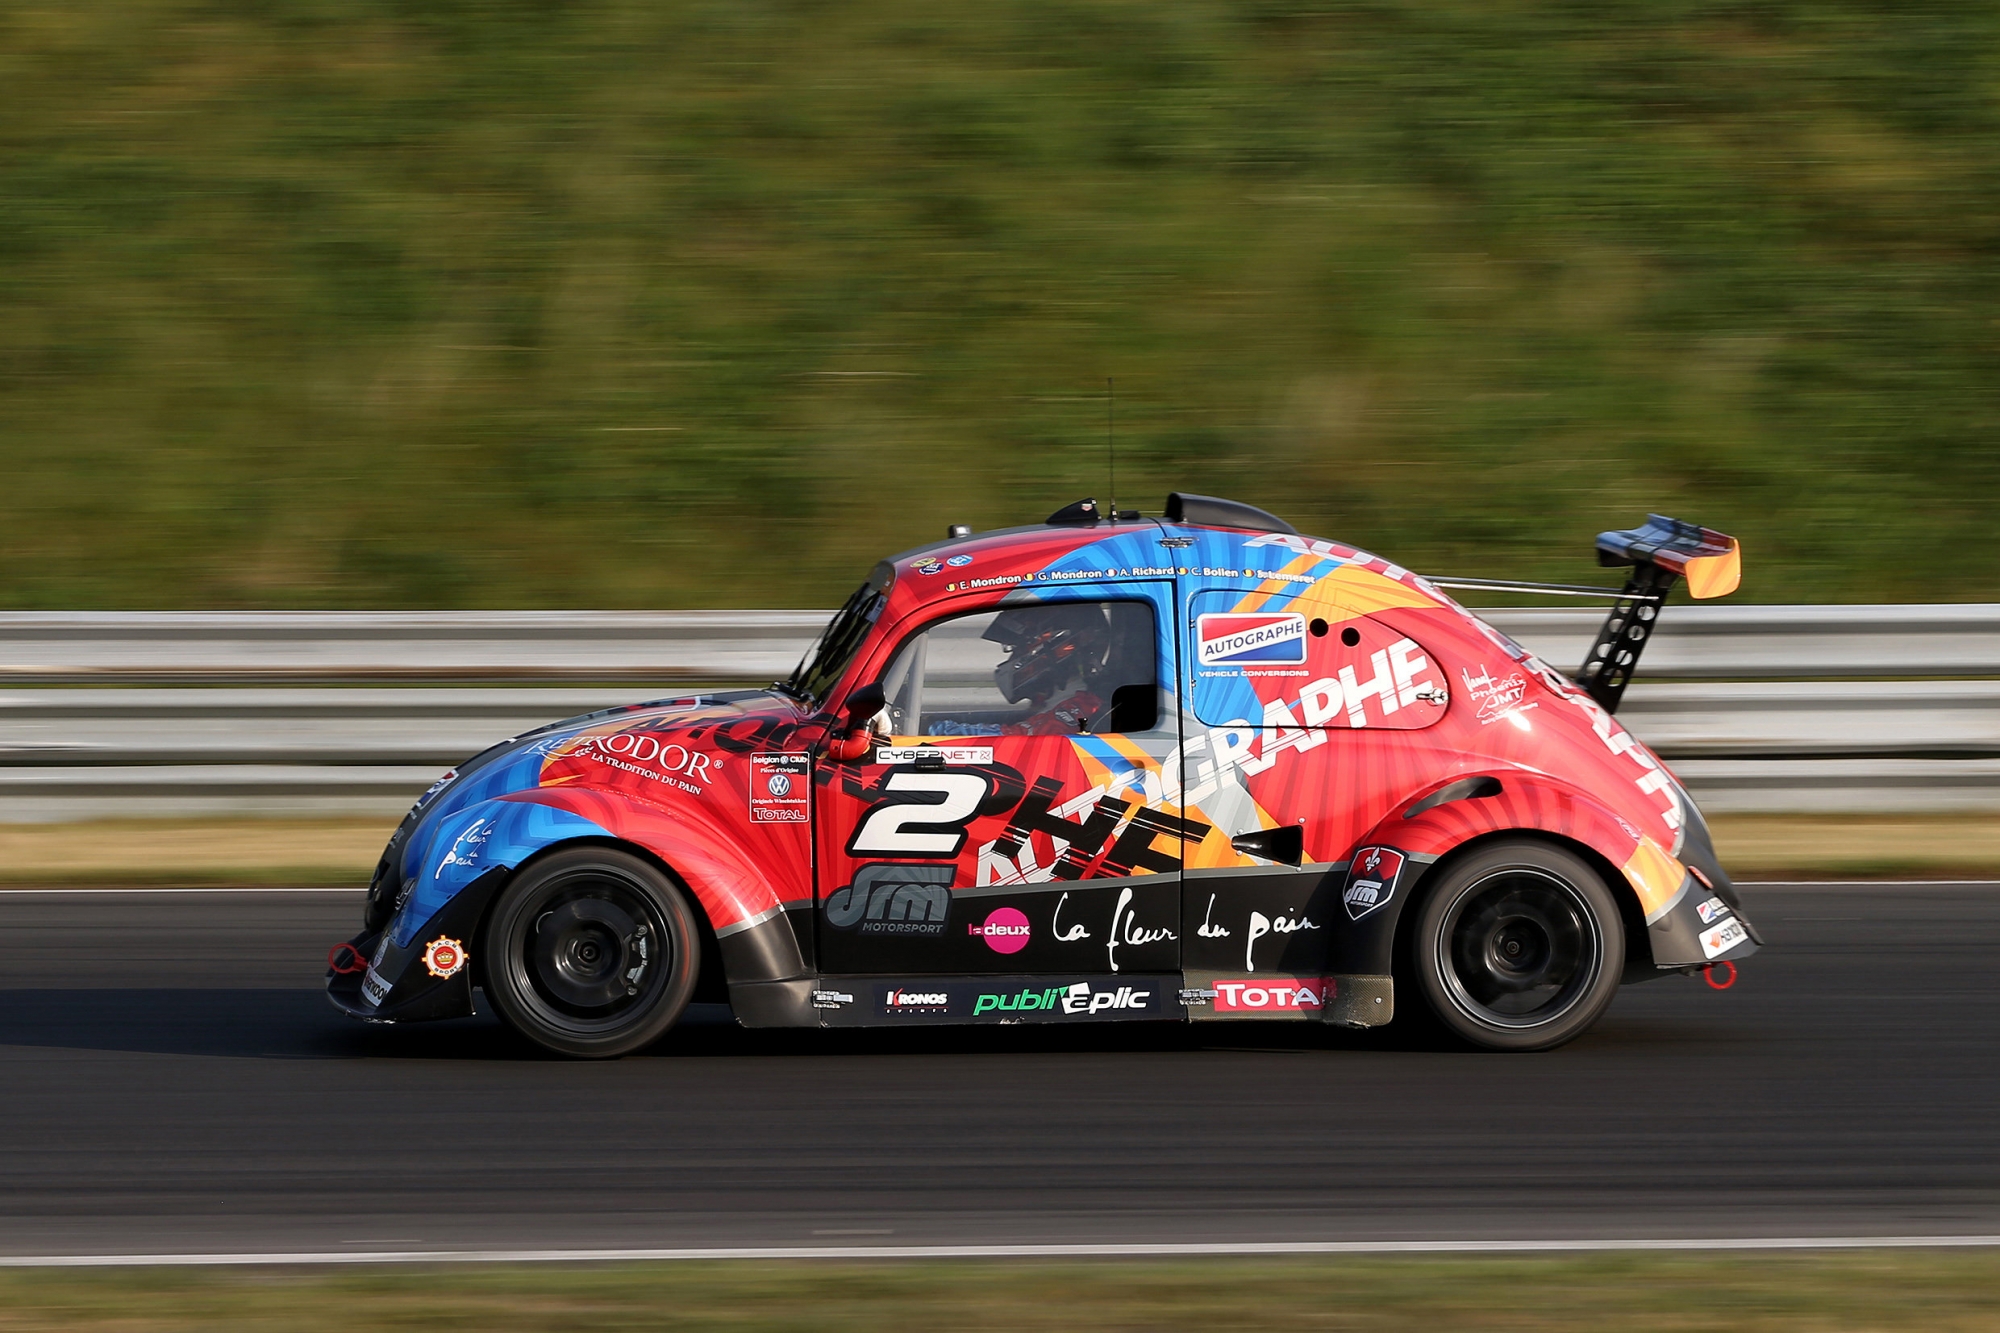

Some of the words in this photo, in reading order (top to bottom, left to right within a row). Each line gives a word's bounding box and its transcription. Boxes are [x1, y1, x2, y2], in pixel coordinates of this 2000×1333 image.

[959, 581, 970, 590] E.
[971, 575, 1022, 589] Mondron
[1037, 572, 1049, 581] G.
[1051, 569, 1102, 580] Mondron
[1119, 568, 1130, 577] A.
[1132, 566, 1175, 576] Richard
[1191, 568, 1202, 576] C.
[1203, 567, 1239, 578] Bollen
[1204, 621, 1304, 657] AUTOGRAPHE
[1470, 679, 1527, 701] Phoenix
[1486, 687, 1522, 709] JMT
[753, 757, 780, 765] Belgian
[590, 752, 604, 763] LA
[605, 756, 661, 781] TRADITION
[660, 775, 677, 787] DU
[677, 780, 702, 795] PAIN
[753, 808, 806, 820] TOTAL
[852, 772, 988, 852] 2
[862, 921, 944, 934] MOTORSPORT
[1106, 887, 1178, 971] fleur
[1197, 893, 1231, 938] du
[1246, 907, 1321, 972] pain
[434, 966, 459, 975] SPORT
[886, 988, 948, 1006] KRONOS
